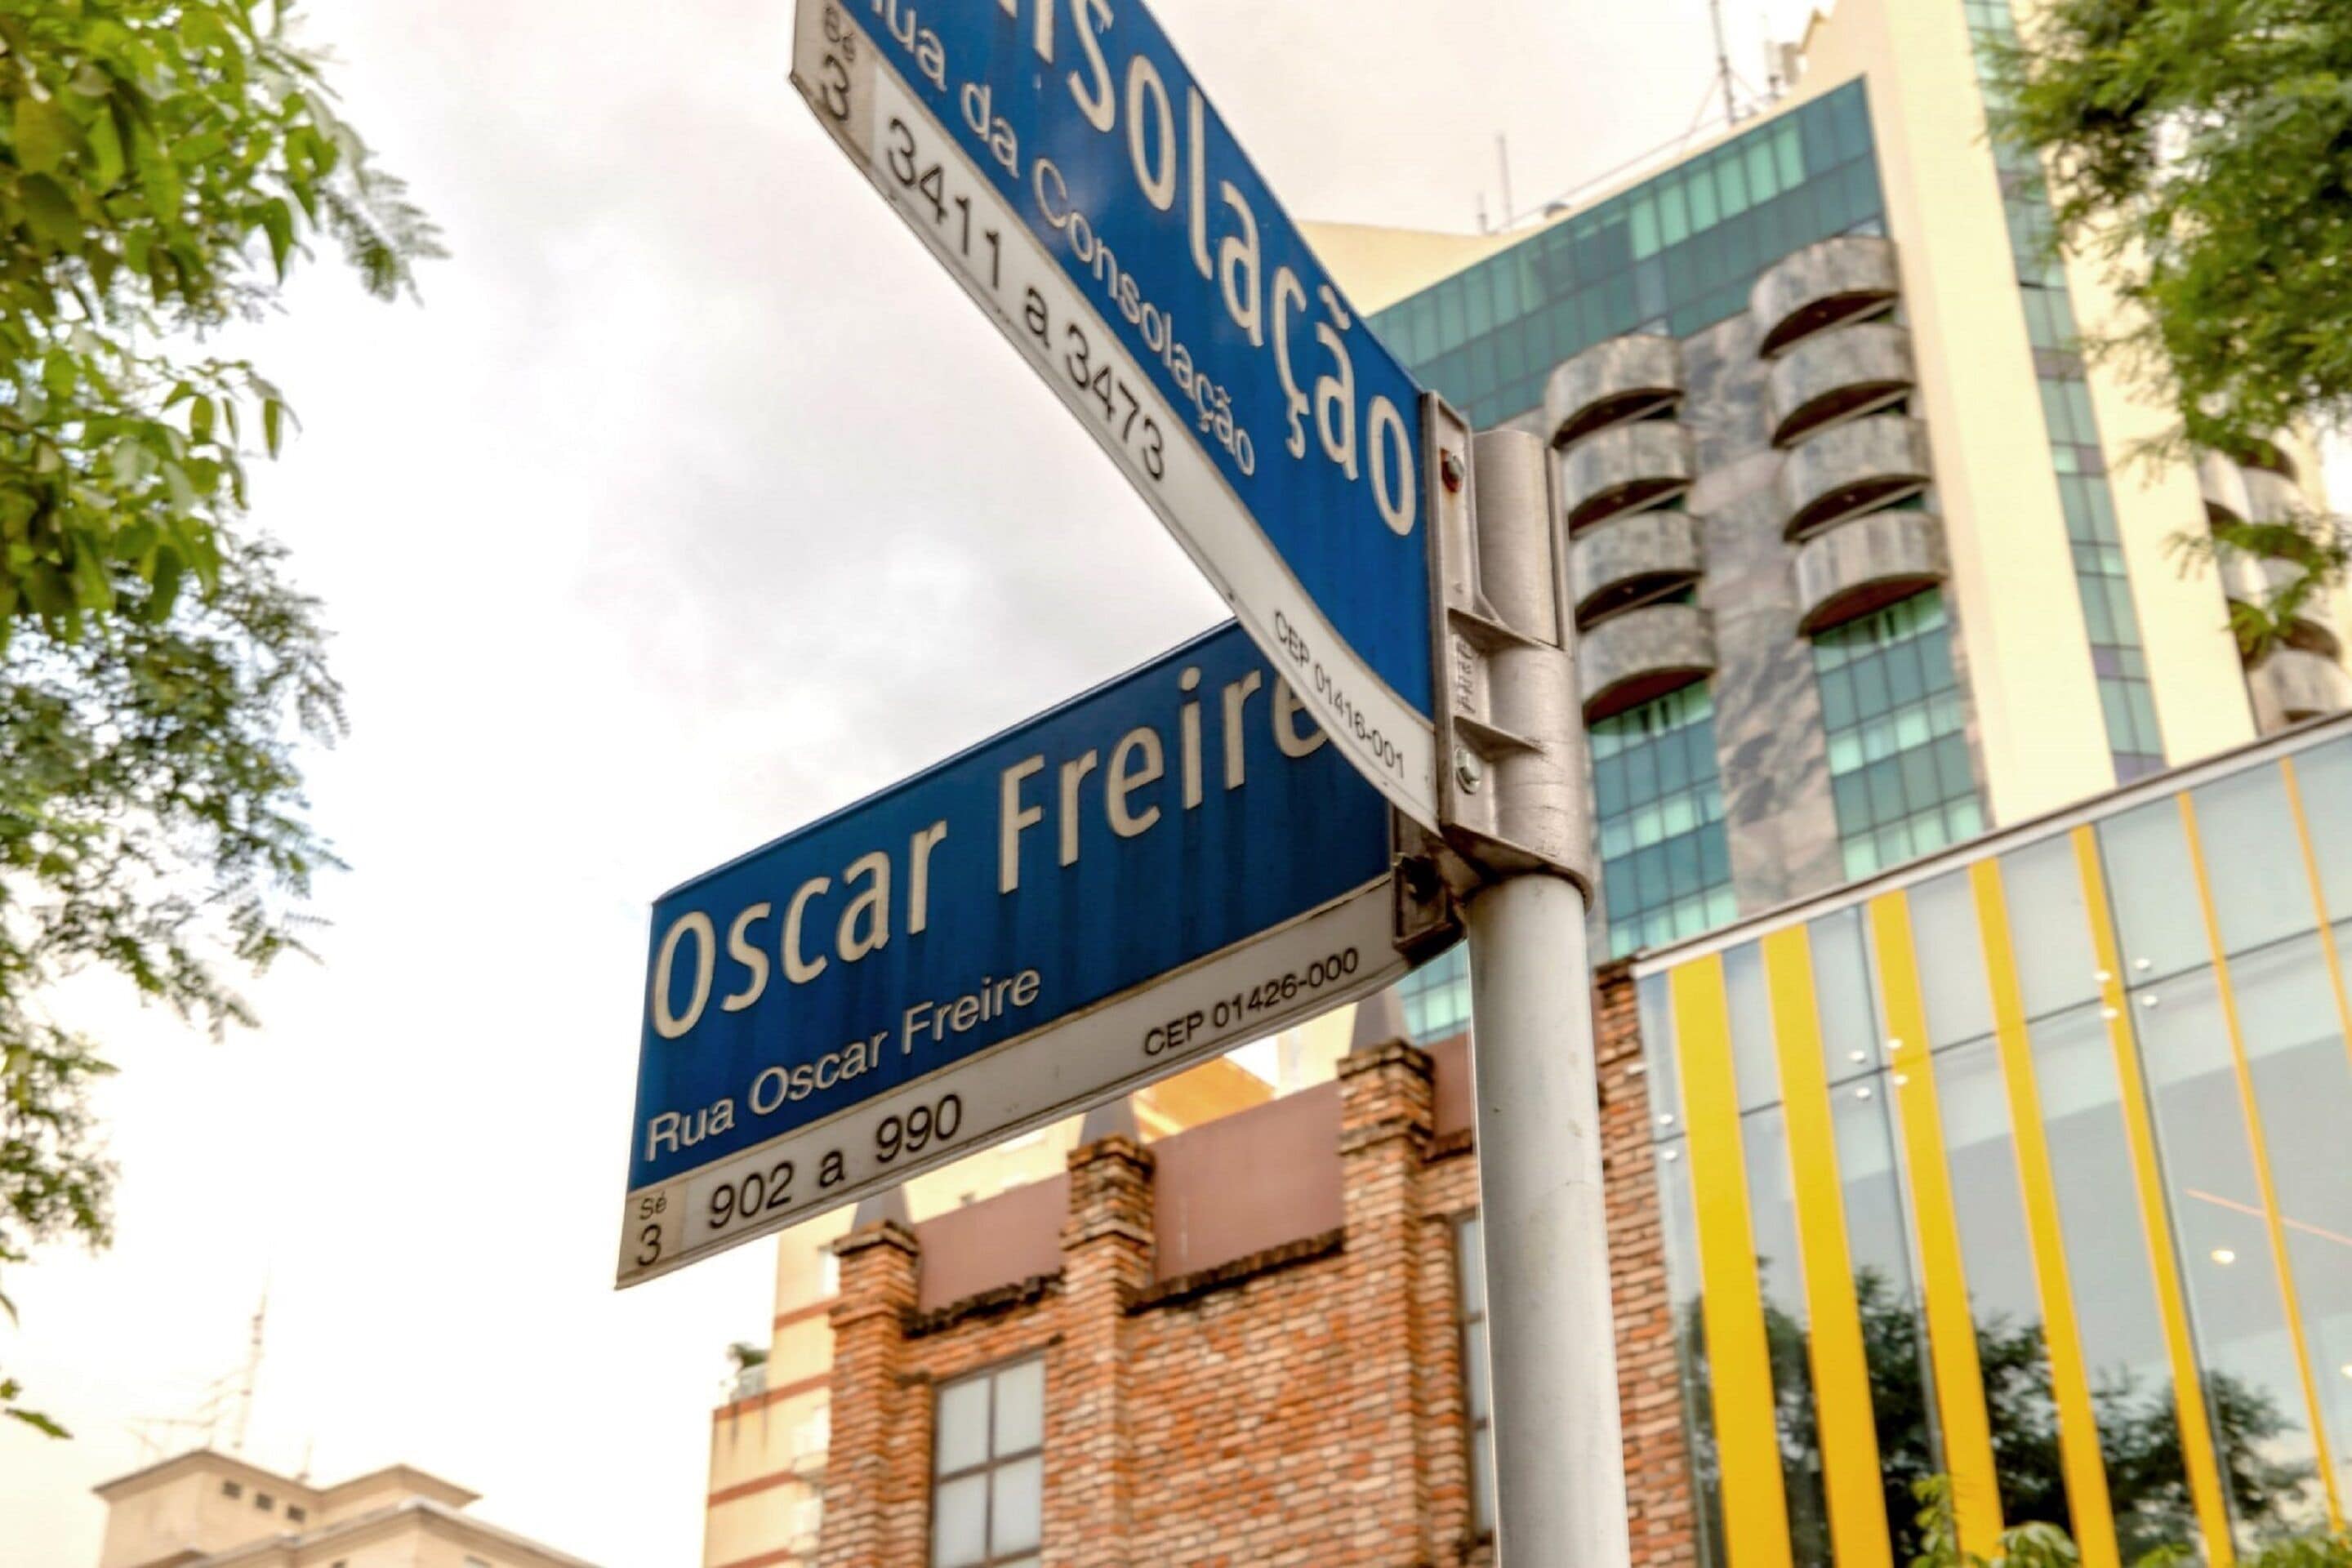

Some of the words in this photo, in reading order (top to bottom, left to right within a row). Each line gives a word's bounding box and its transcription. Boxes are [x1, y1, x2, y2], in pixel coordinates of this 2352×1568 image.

[819, 54, 851, 122] 3
[871, 0, 947, 91] ua
[960, 82, 1018, 179] da
[1032, 158, 1255, 476] Consolação
[886, 118, 1001, 290] 3411
[1024, 286, 1051, 351] a
[1063, 323, 1165, 483] 3473
[1000, 0, 1416, 536] solação
[1273, 610, 1310, 669] CEP
[1314, 666, 1405, 780] 01416-001
[653, 819, 949, 1040] Oscar
[1144, 1011, 1204, 1057] CEP
[1214, 947, 1360, 1028] 01426-000
[644, 1096, 736, 1162] Rua
[748, 1030, 889, 1116] Oscar
[902, 968, 1041, 1055] Freire
[636, 1223, 662, 1266] 3
[639, 1190, 667, 1221] Sé
[709, 1160, 795, 1230] 902
[818, 1149, 846, 1189] a
[875, 1094, 963, 1165] 990
